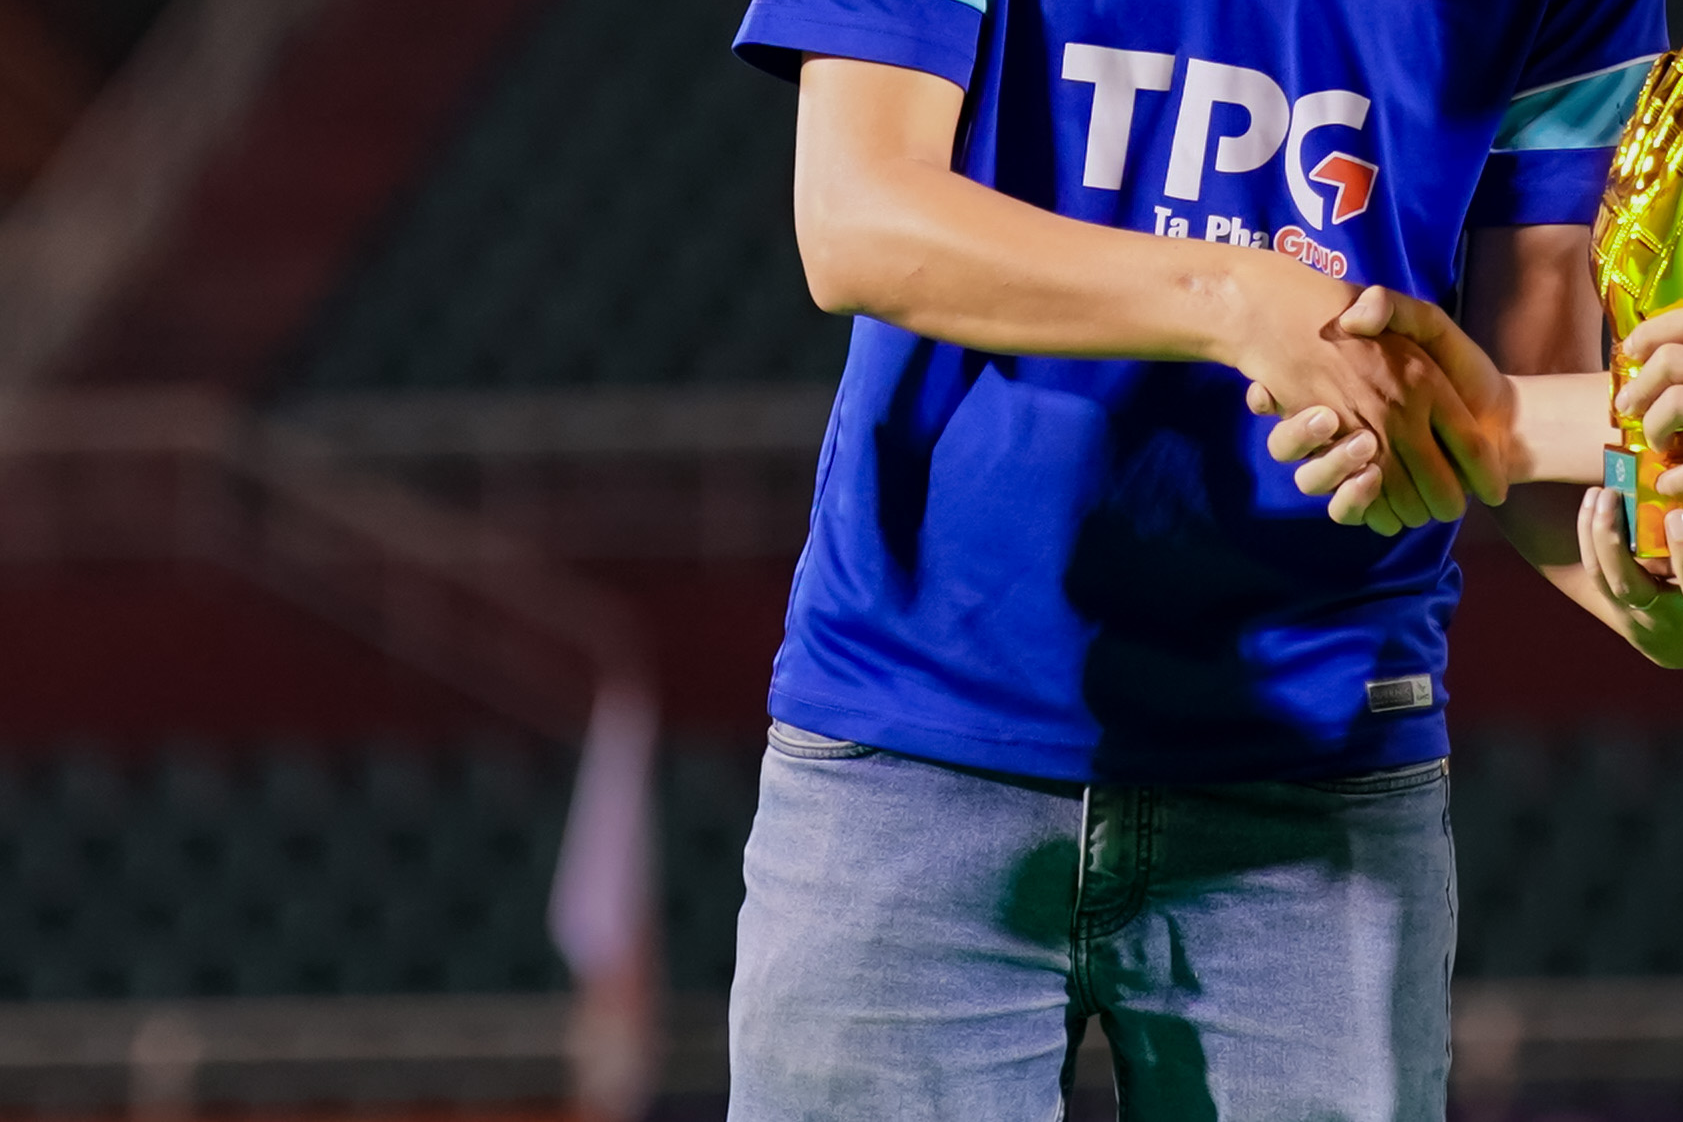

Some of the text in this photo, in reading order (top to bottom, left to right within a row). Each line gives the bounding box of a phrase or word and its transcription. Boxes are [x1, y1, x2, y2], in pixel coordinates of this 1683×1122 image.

[1061, 43, 1379, 231] TPG
[1154, 205, 1348, 279] Ta Pha Group
